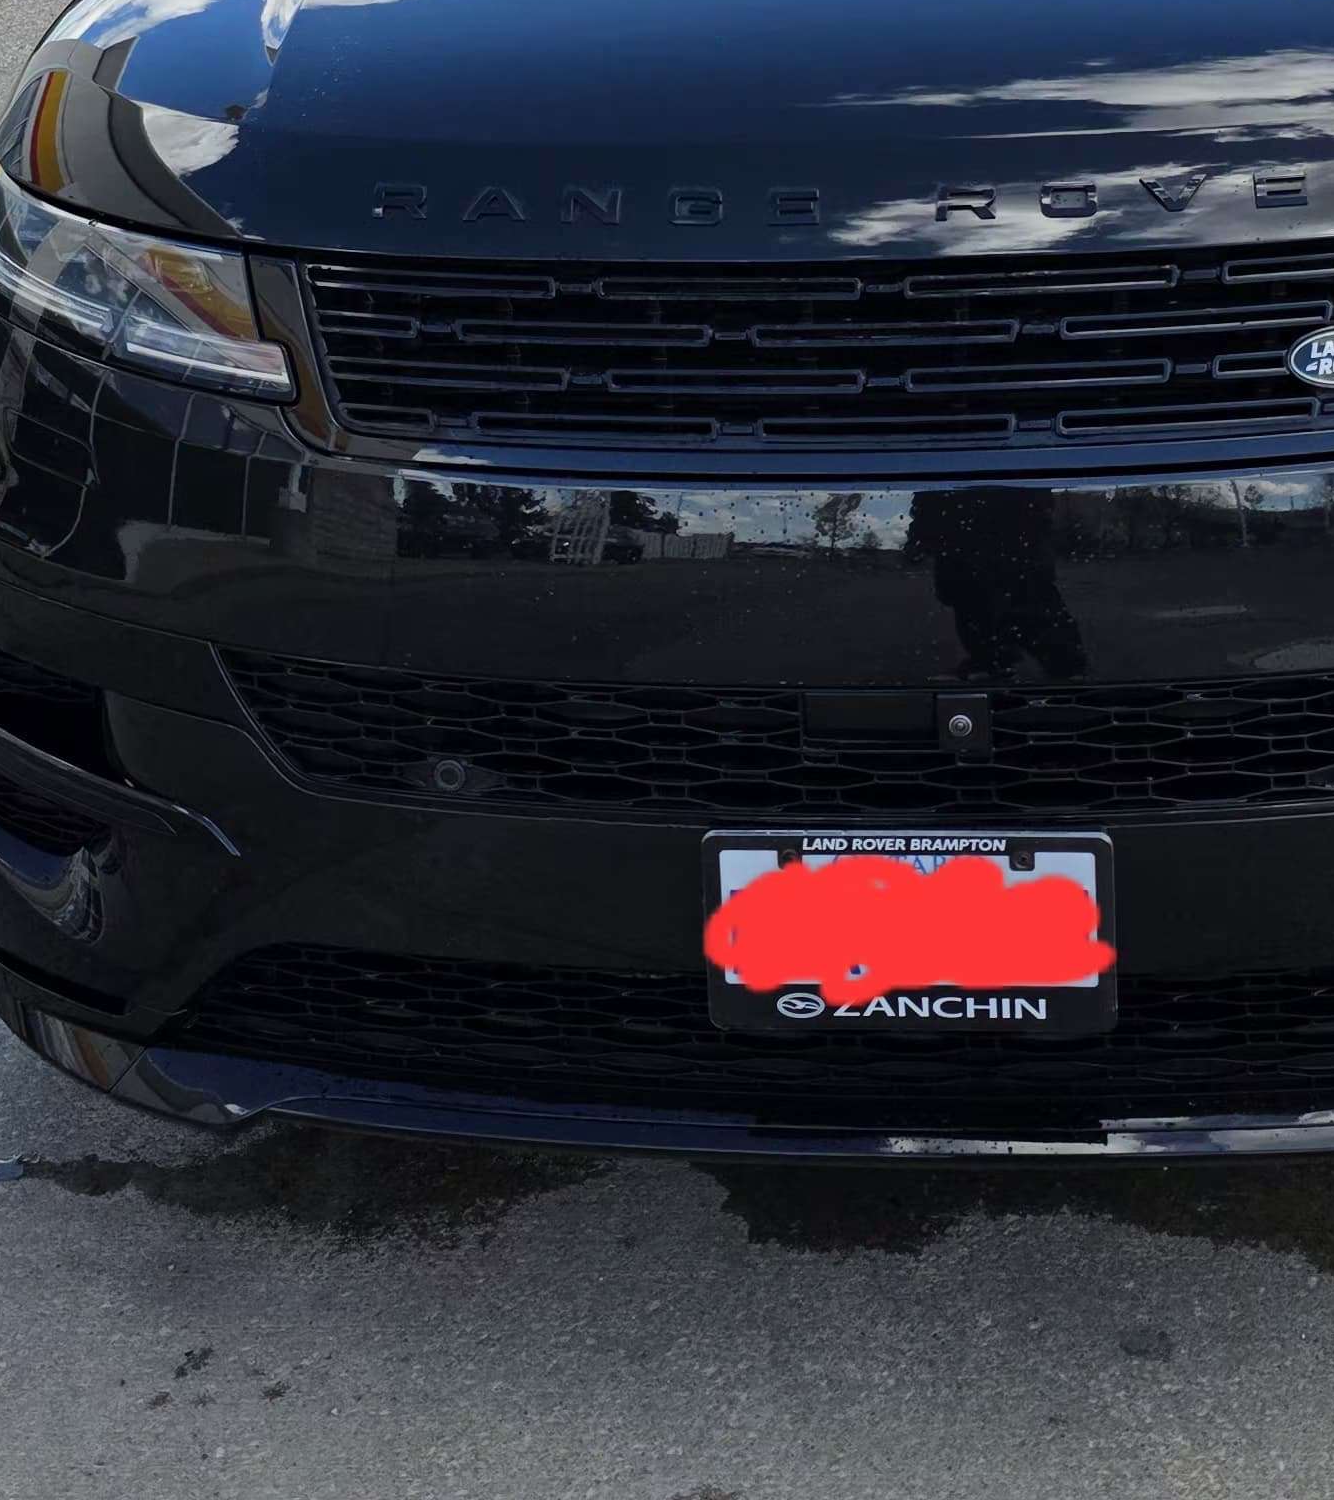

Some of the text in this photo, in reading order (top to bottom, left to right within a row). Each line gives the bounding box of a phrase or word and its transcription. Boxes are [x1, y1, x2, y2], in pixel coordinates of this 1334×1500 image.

[372, 181, 822, 226] RANGE
[802, 837, 1007, 852] LAND ROVER BRAMPTON
[833, 996, 1047, 1020] ZANCHIN
